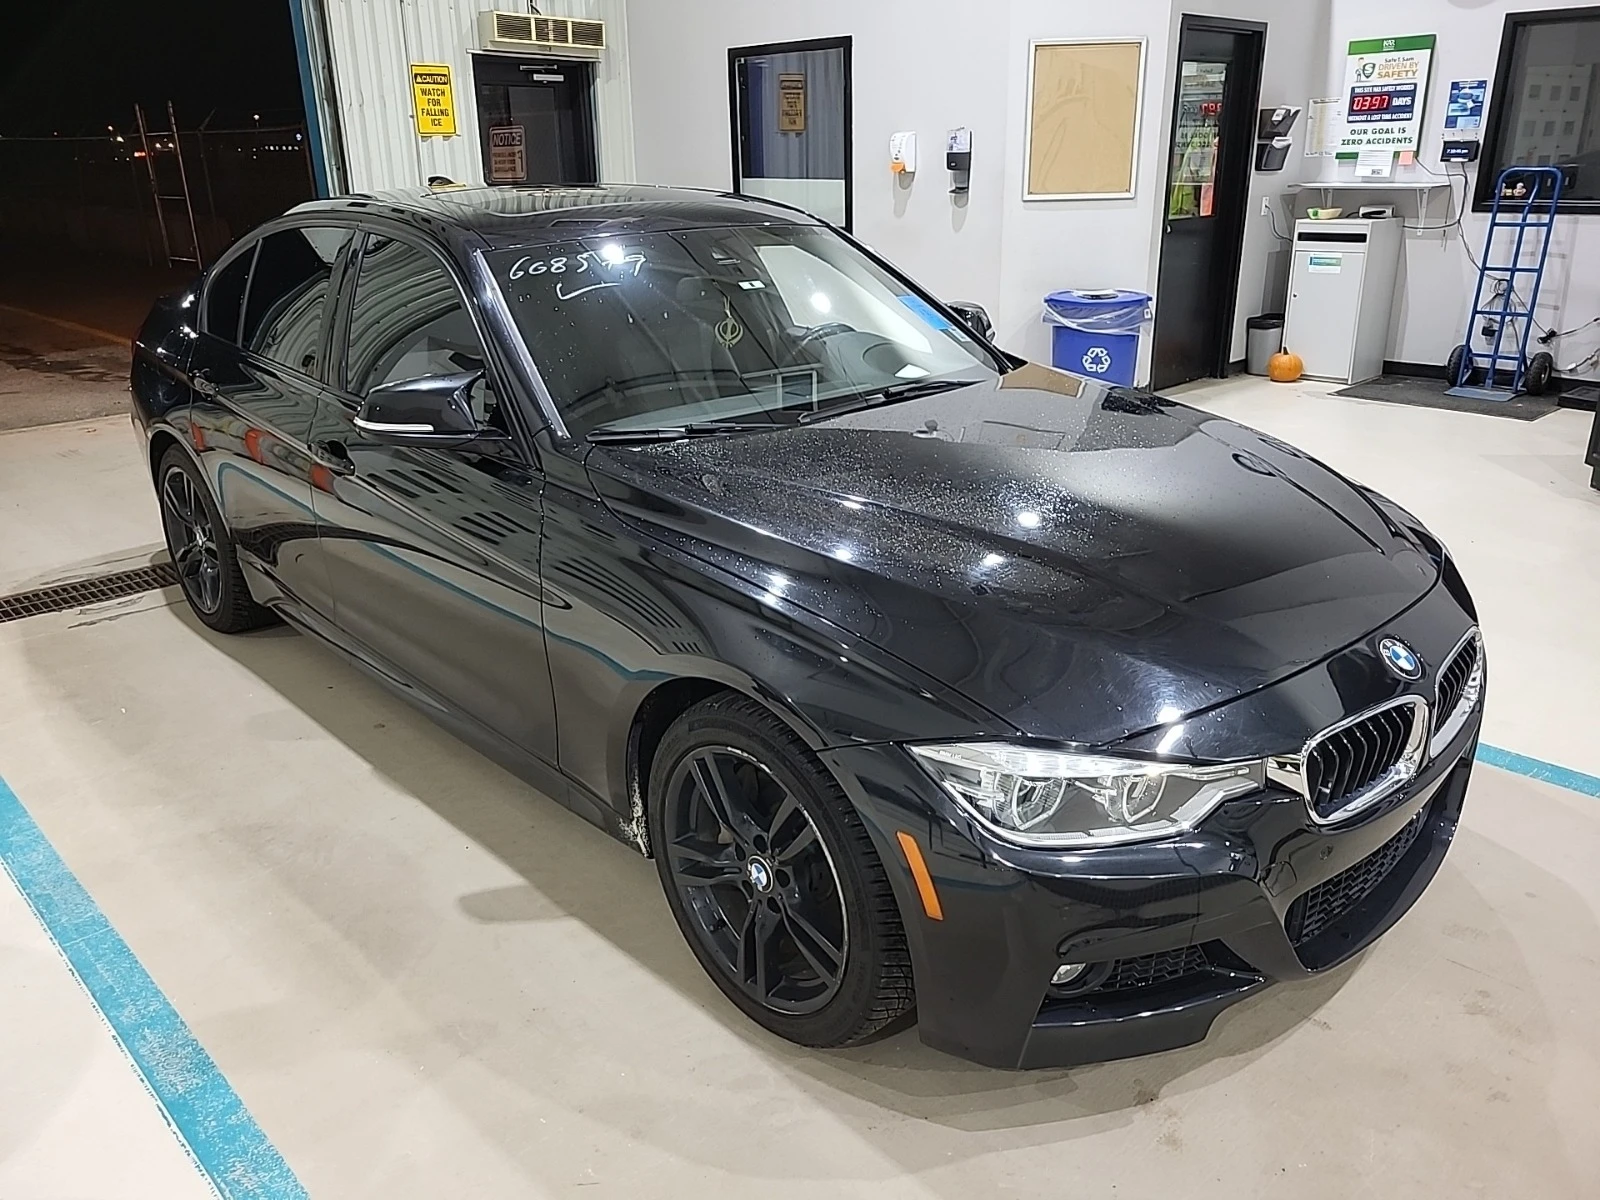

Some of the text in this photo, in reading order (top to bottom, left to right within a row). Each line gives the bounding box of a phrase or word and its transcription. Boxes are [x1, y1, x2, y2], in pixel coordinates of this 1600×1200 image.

[1378, 61, 1419, 71] DRIVEN BY
[1377, 69, 1418, 79] SAFETY
[422, 75, 448, 83] CAUTION
[420, 88, 446, 97] WATCH
[427, 98, 441, 107] FOR
[1353, 95, 1412, 110] 0397 DAYS
[421, 108, 449, 117] FALLING
[431, 118, 443, 127] ICE
[1350, 128, 1368, 136] OUR
[1371, 127, 1395, 135] GOAL
[493, 133, 521, 146] NOTICE
[1340, 137, 1413, 146] ZERO ACCIDENTS
